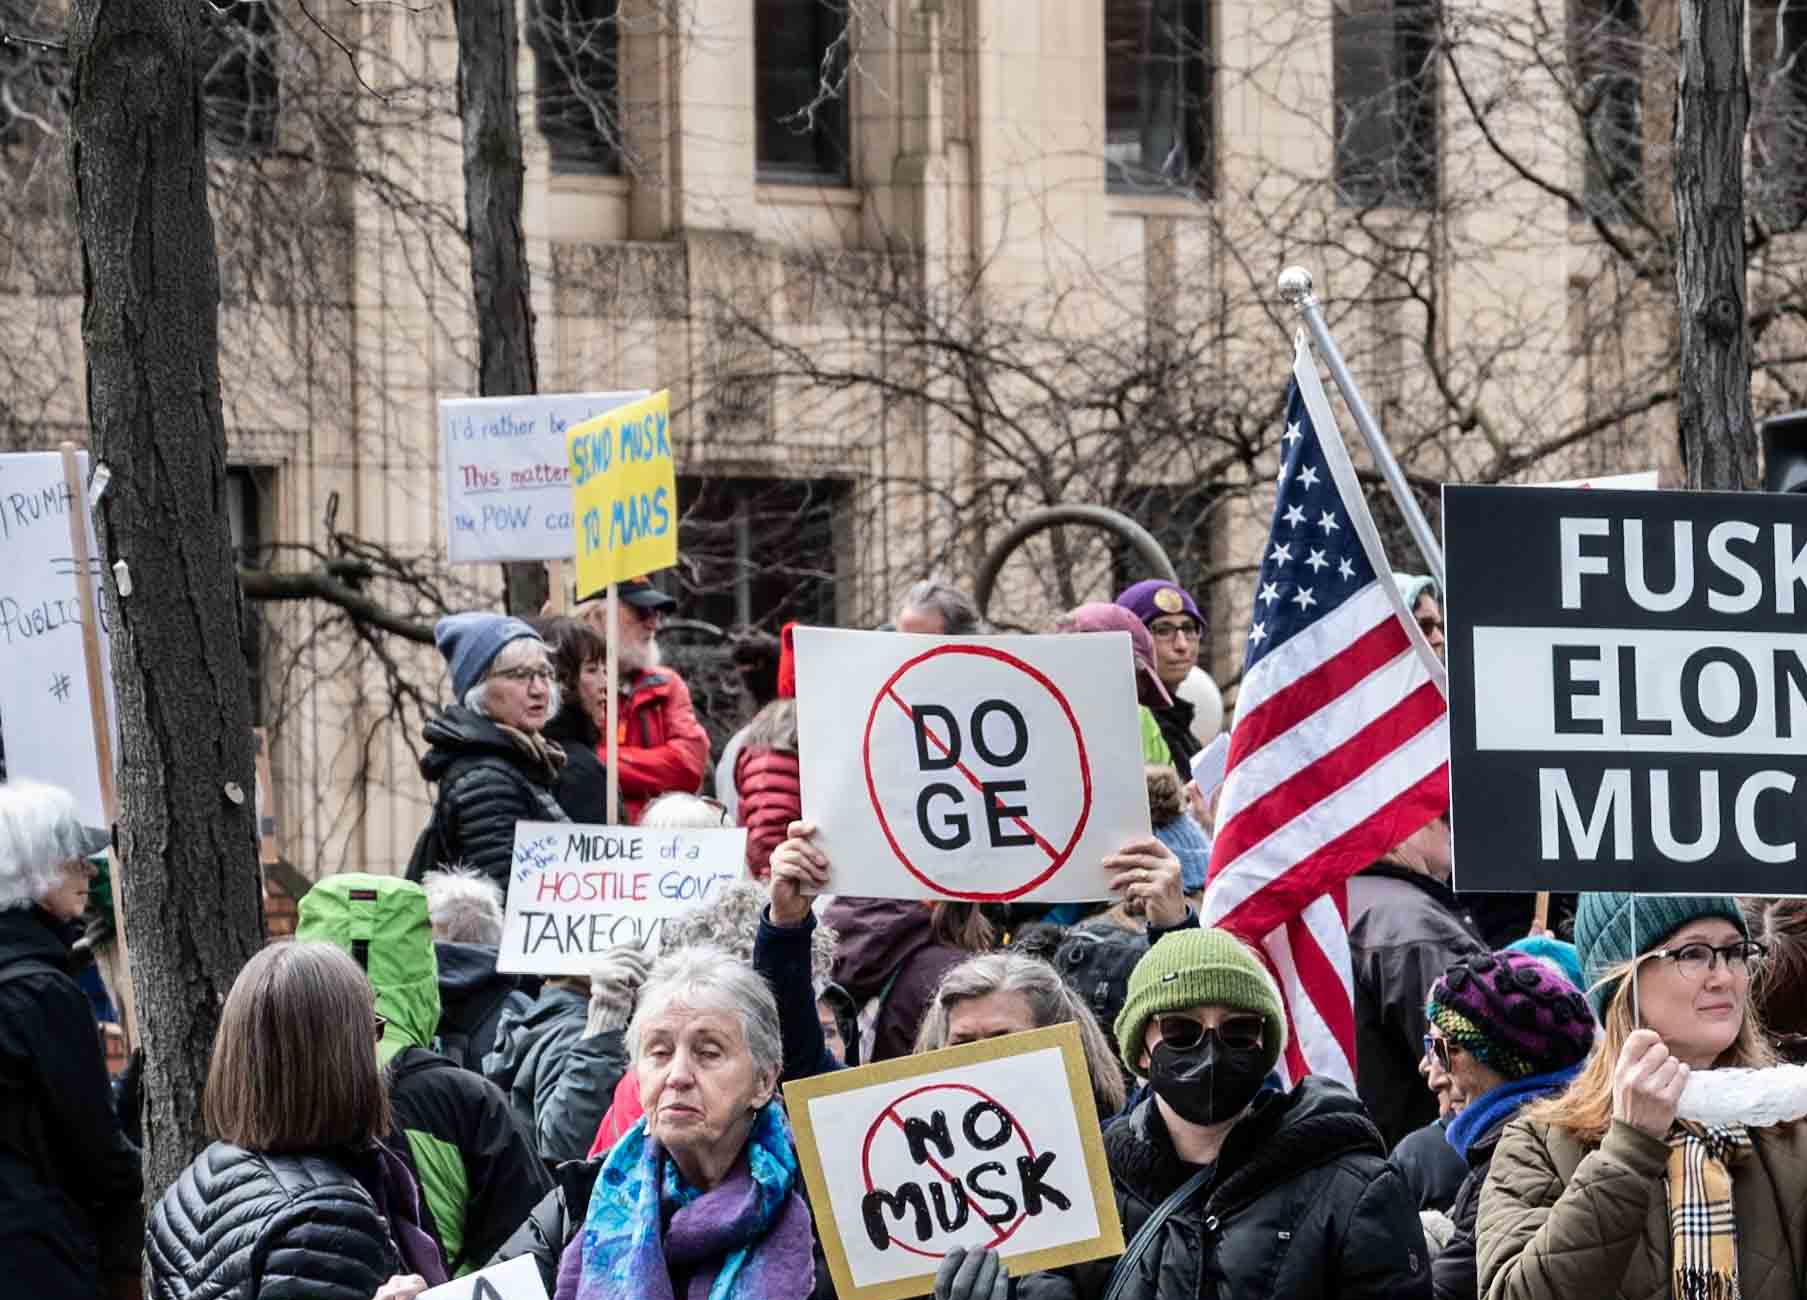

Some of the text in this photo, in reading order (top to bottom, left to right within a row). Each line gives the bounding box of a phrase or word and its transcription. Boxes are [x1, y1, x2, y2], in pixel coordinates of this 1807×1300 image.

[573, 411, 672, 486] SEND MUSK
[481, 503, 532, 532] POW
[582, 485, 669, 557] TO MARS
[912, 699, 1029, 771] DO
[564, 833, 643, 863] MIDDLE
[660, 836, 679, 860] of
[685, 845, 700, 860] a
[916, 780, 1036, 850] GE
[537, 872, 651, 902] HOSTILE
[904, 1100, 1014, 1164] NO
[861, 1150, 1072, 1250] MUSK
